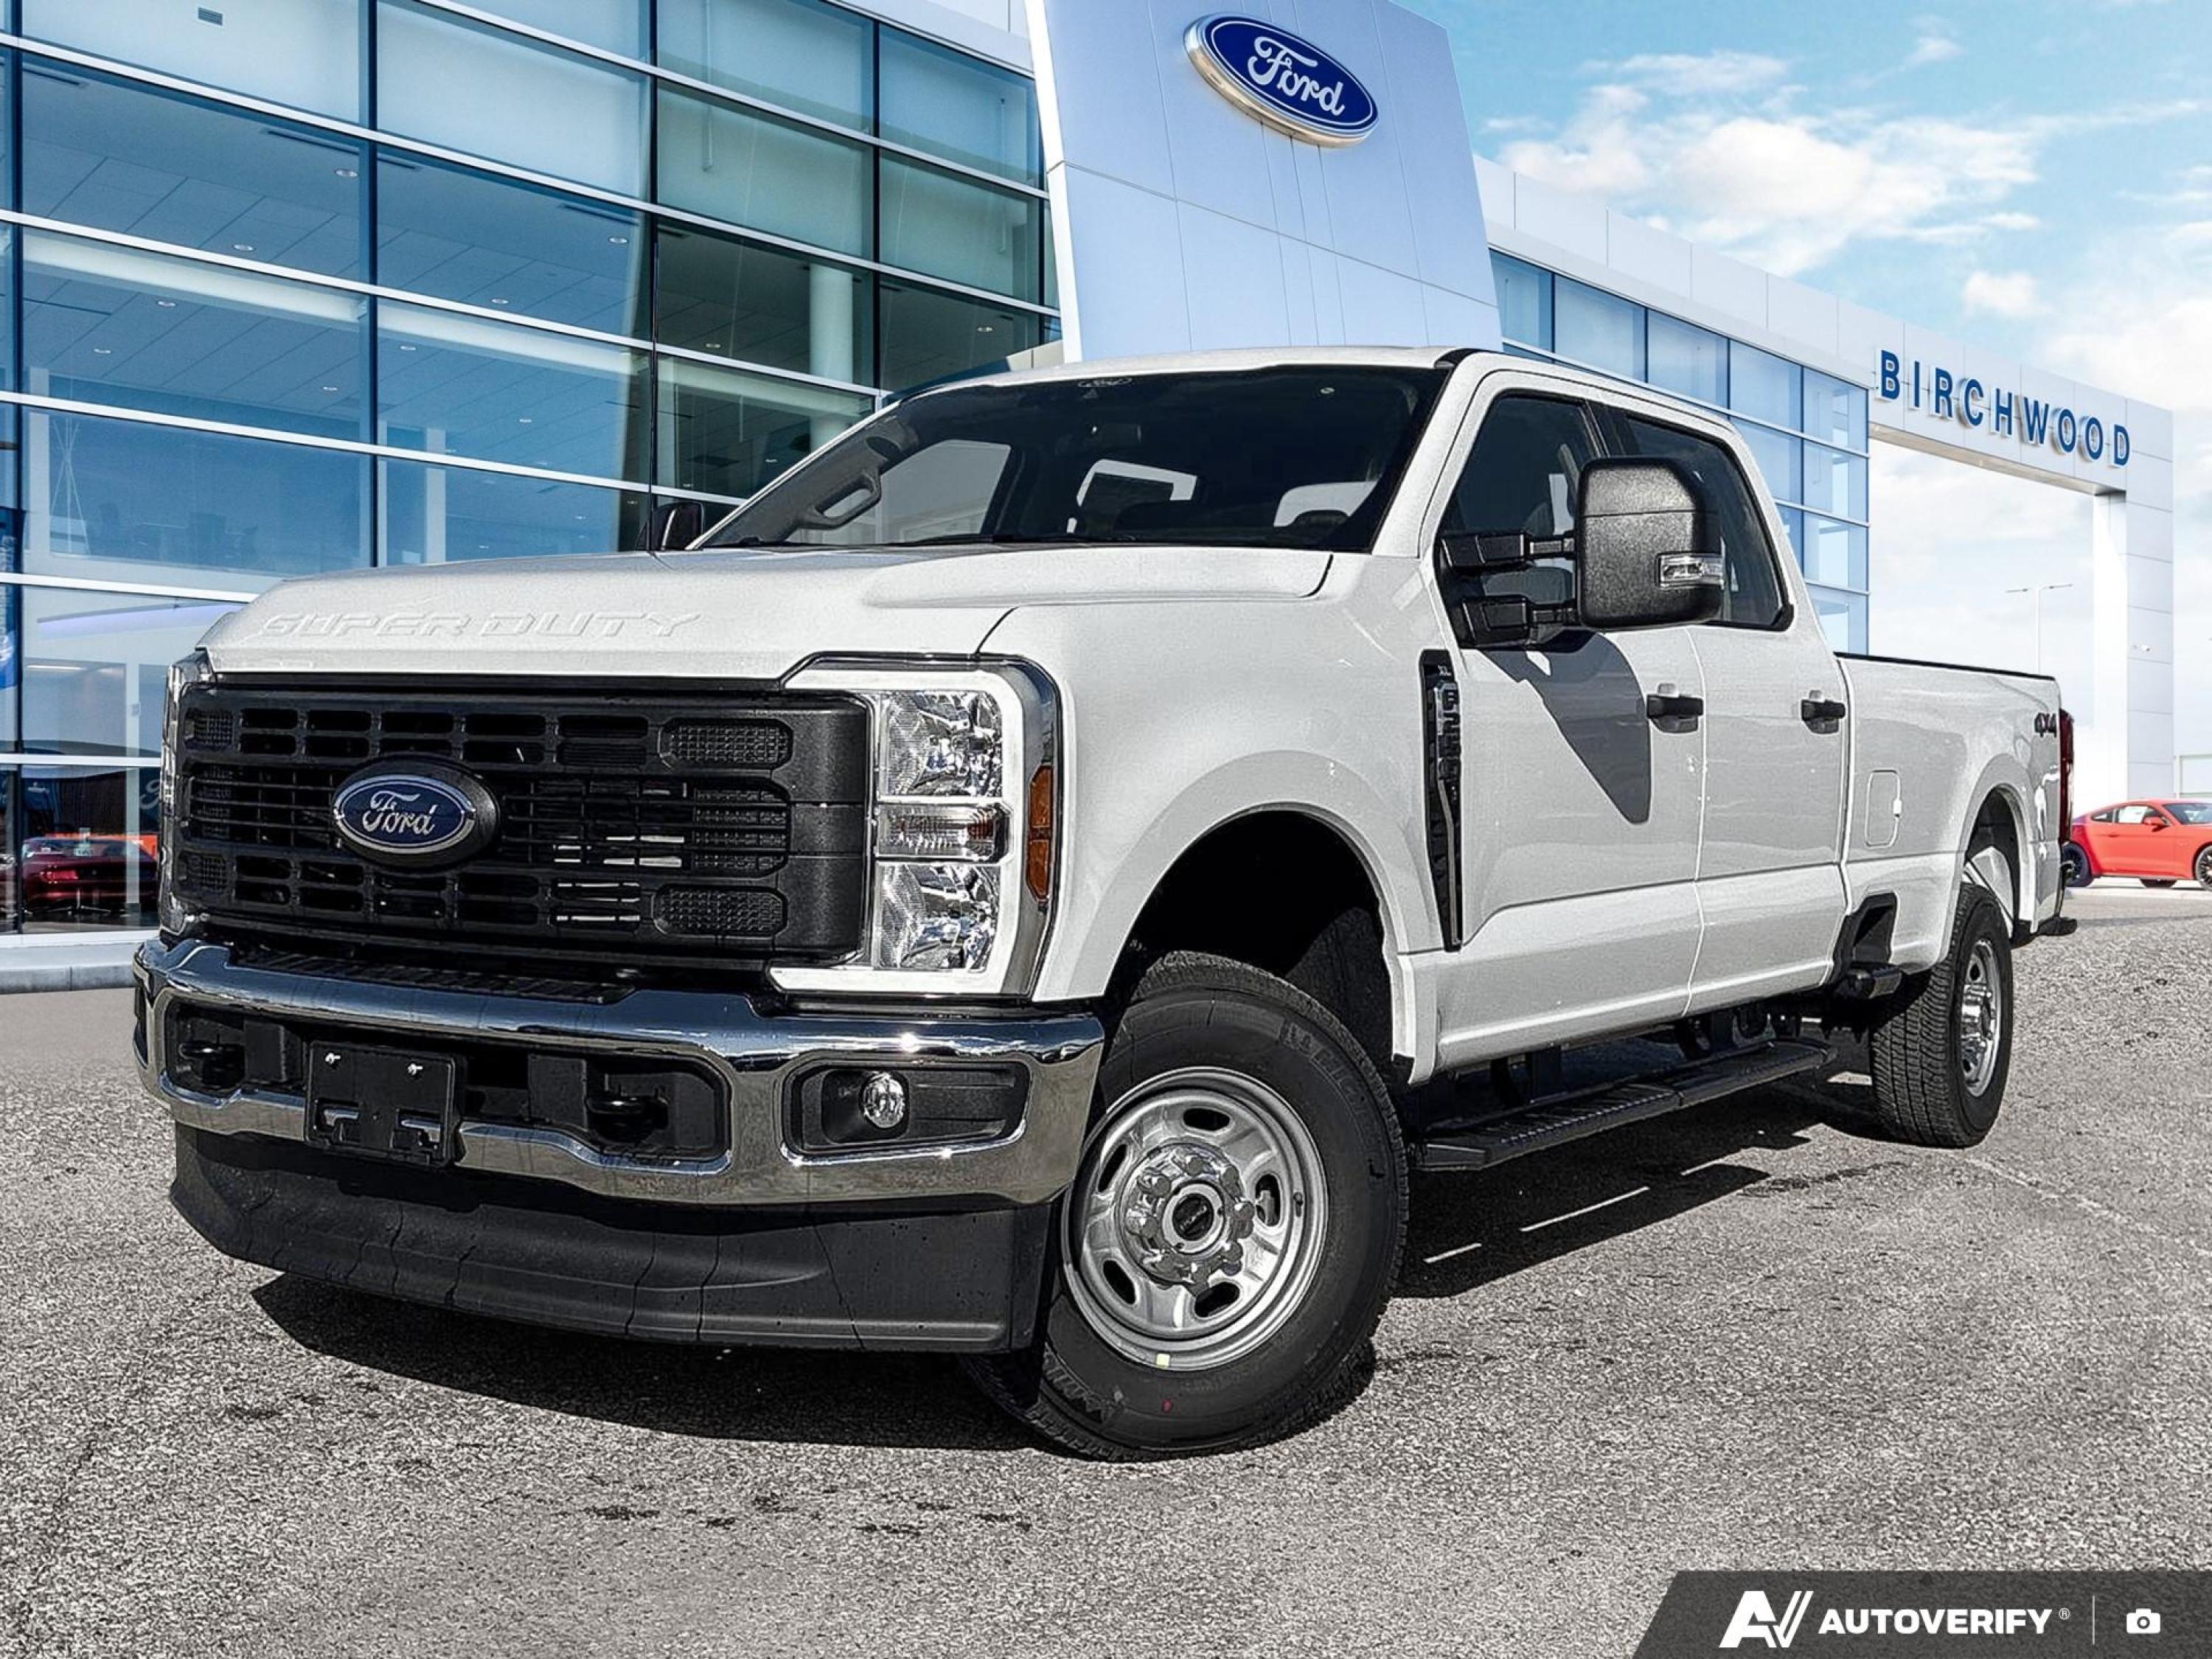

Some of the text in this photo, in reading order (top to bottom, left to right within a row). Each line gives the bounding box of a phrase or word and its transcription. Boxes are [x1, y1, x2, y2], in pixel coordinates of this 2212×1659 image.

[1248, 36, 1345, 116] Ford
[1880, 349, 2131, 467] BIRCHWOOD
[262, 612, 701, 637] SUPER DUTY
[362, 790, 439, 835] Ford
